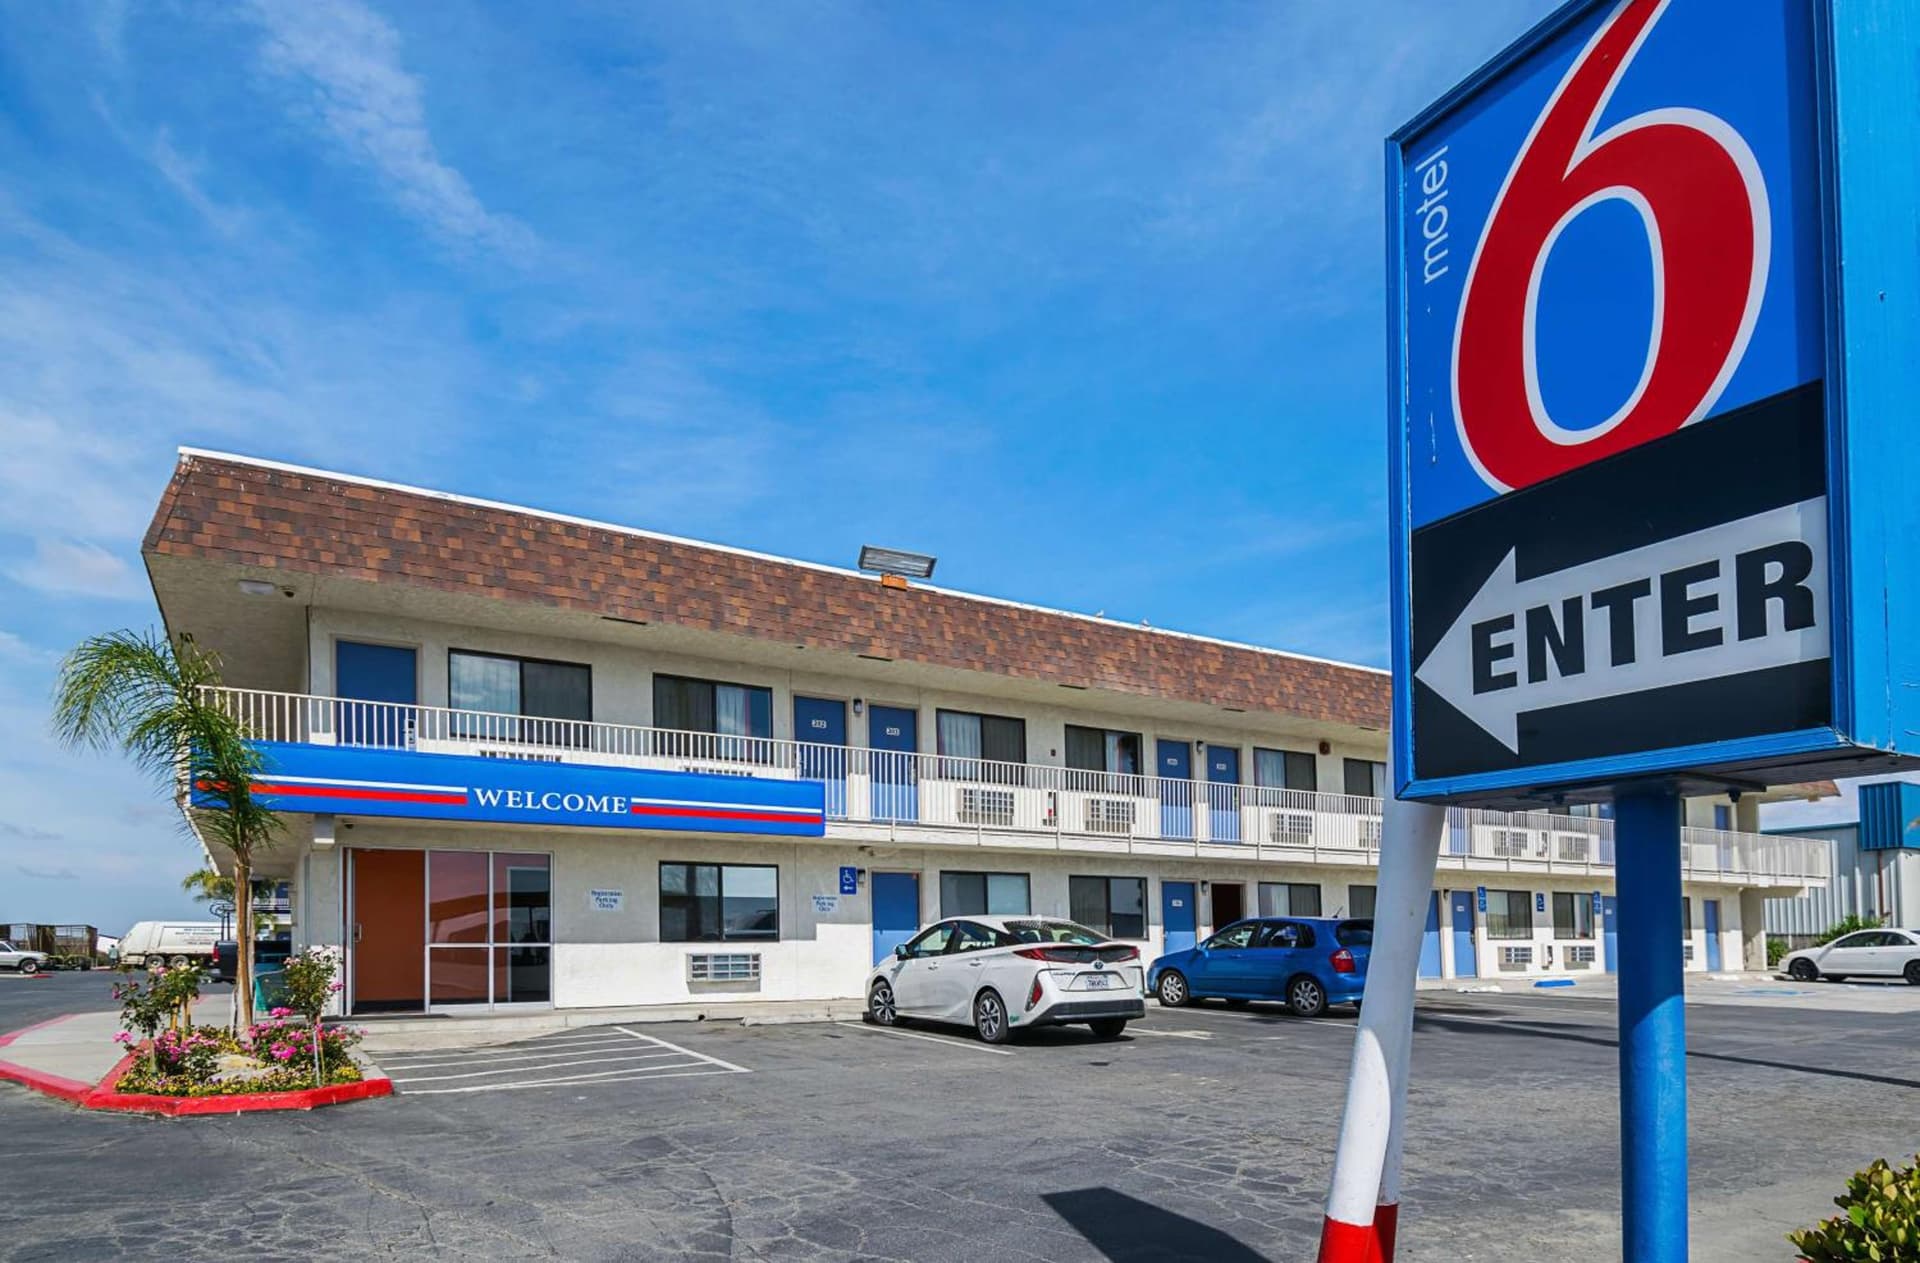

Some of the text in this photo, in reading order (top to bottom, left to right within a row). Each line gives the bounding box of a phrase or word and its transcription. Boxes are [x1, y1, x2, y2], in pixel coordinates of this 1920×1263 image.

[1414, 145, 1449, 285] motel
[1450, 0, 1772, 495] 6
[1471, 541, 1816, 695] ENTER
[473, 787, 628, 814] WELCOME
